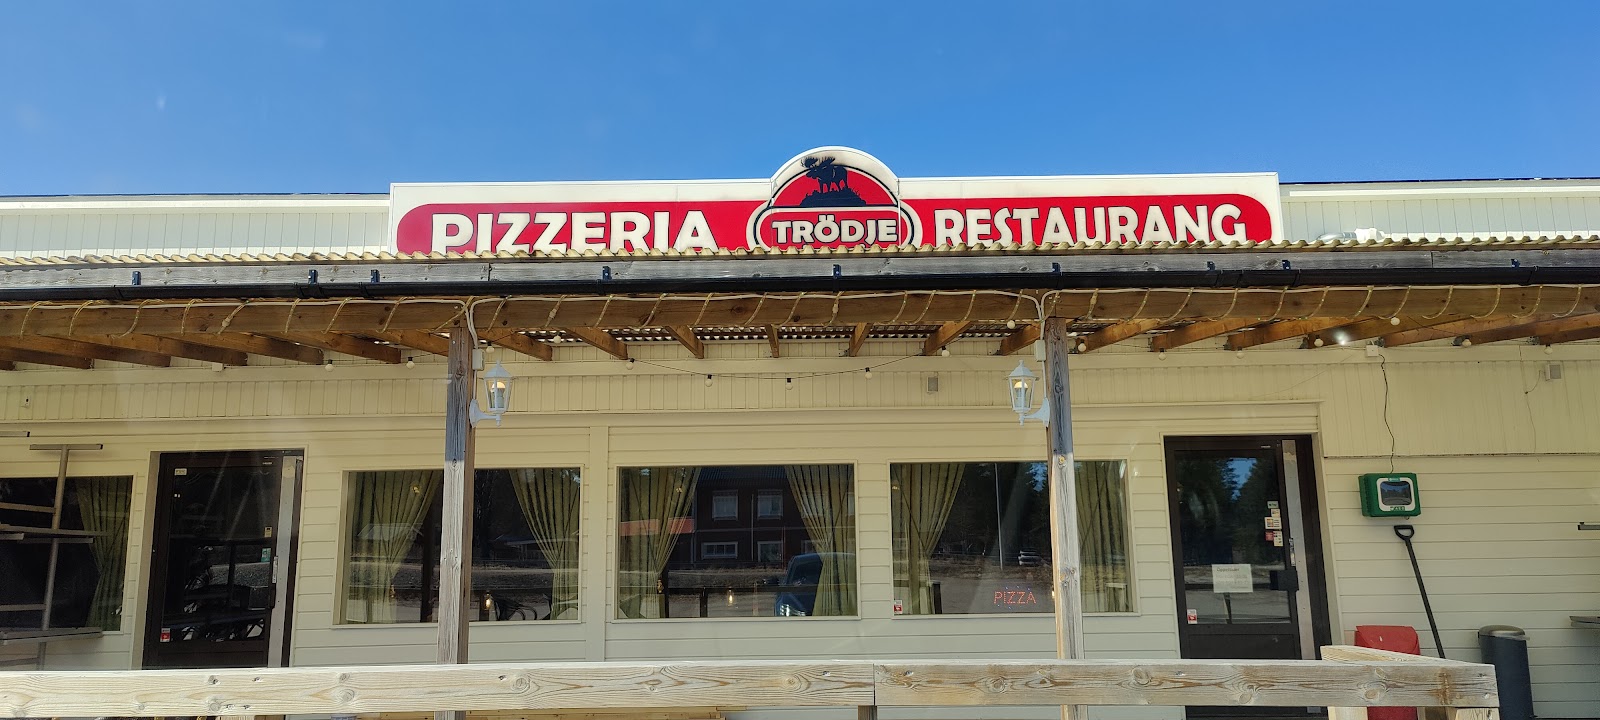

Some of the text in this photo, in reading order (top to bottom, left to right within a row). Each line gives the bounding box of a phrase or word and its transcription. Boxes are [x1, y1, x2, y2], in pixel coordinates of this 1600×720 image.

[430, 203, 1247, 256] PIZZERIA TRÖDJE RESTAURANG
[993, 590, 1037, 604] PIZZA
